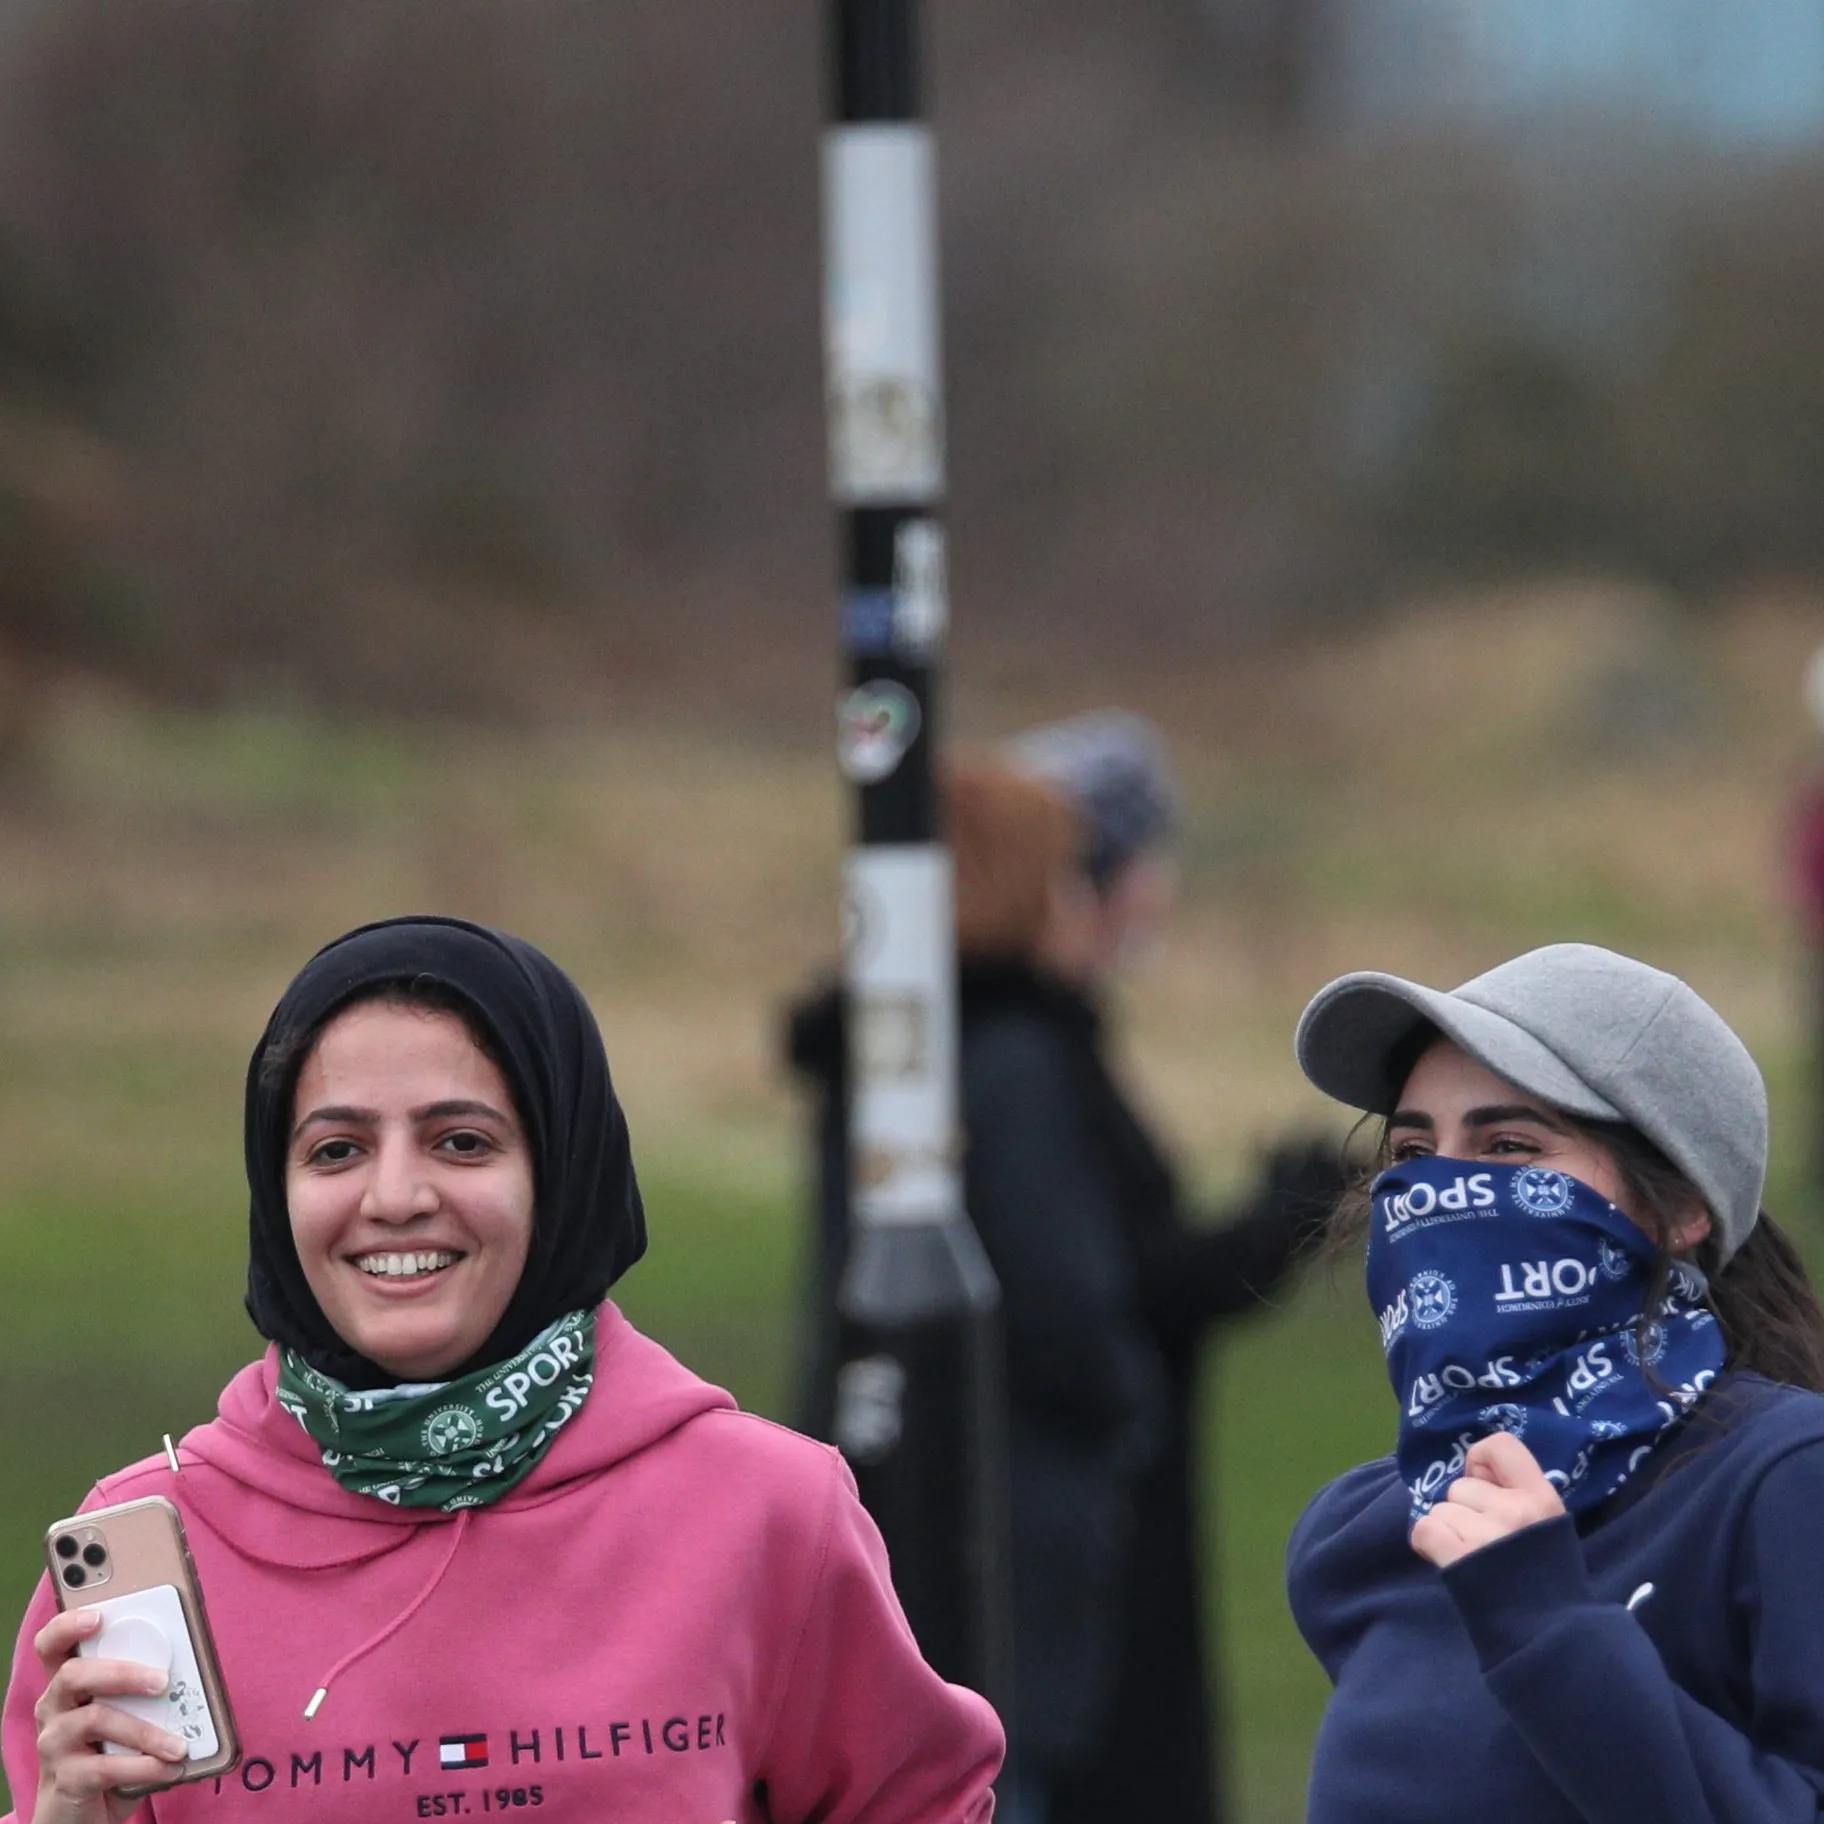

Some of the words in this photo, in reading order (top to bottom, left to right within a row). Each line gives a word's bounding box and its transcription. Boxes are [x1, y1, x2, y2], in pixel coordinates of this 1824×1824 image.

[1384, 1173, 1496, 1232] SPORT
[1494, 1258, 1597, 1301] ORT
[1408, 1356, 1521, 1417] SPORT
[509, 1713, 726, 1765] HILFIGER
[416, 1792, 472, 1818] EST.
[483, 1785, 545, 1812] 1985
